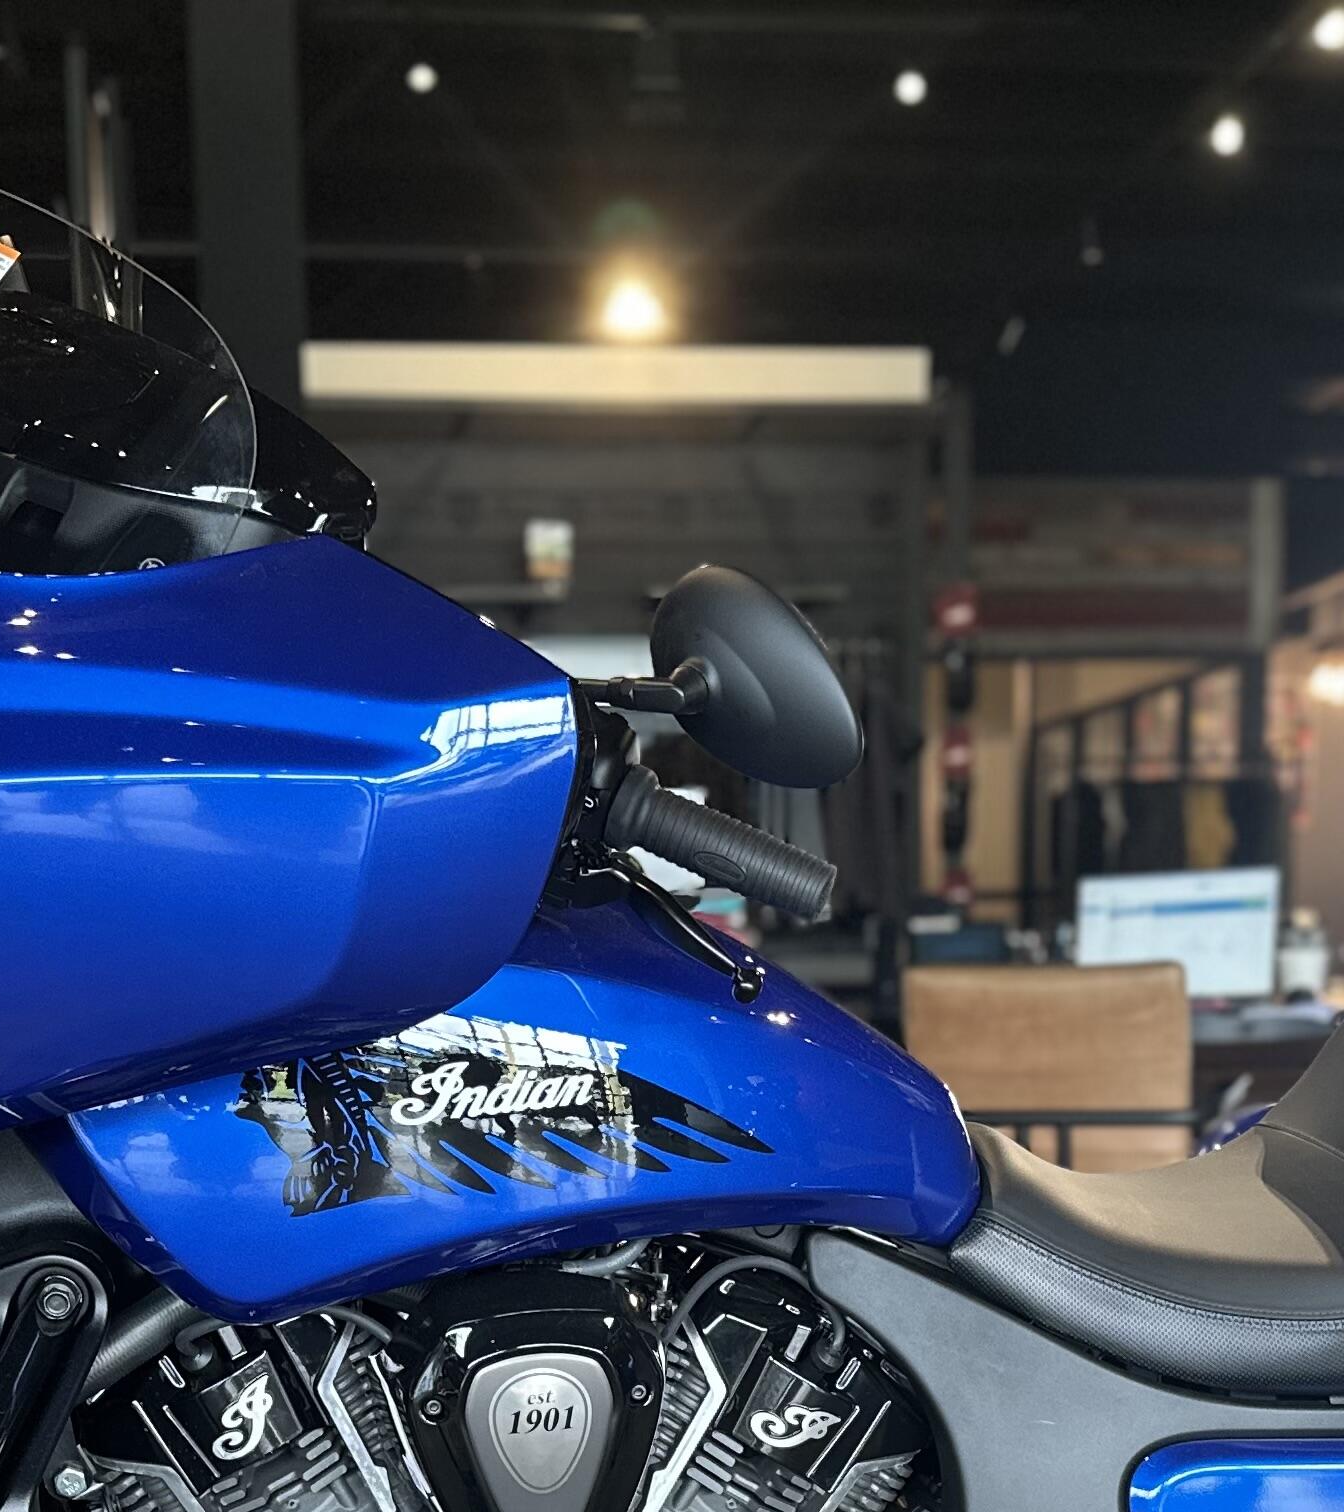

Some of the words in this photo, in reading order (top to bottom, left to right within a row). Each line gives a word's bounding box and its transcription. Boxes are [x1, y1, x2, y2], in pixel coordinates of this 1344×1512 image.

[390, 1061, 595, 1127] Indian
[522, 1389, 557, 1407] est.
[508, 1403, 578, 1437] 1901
